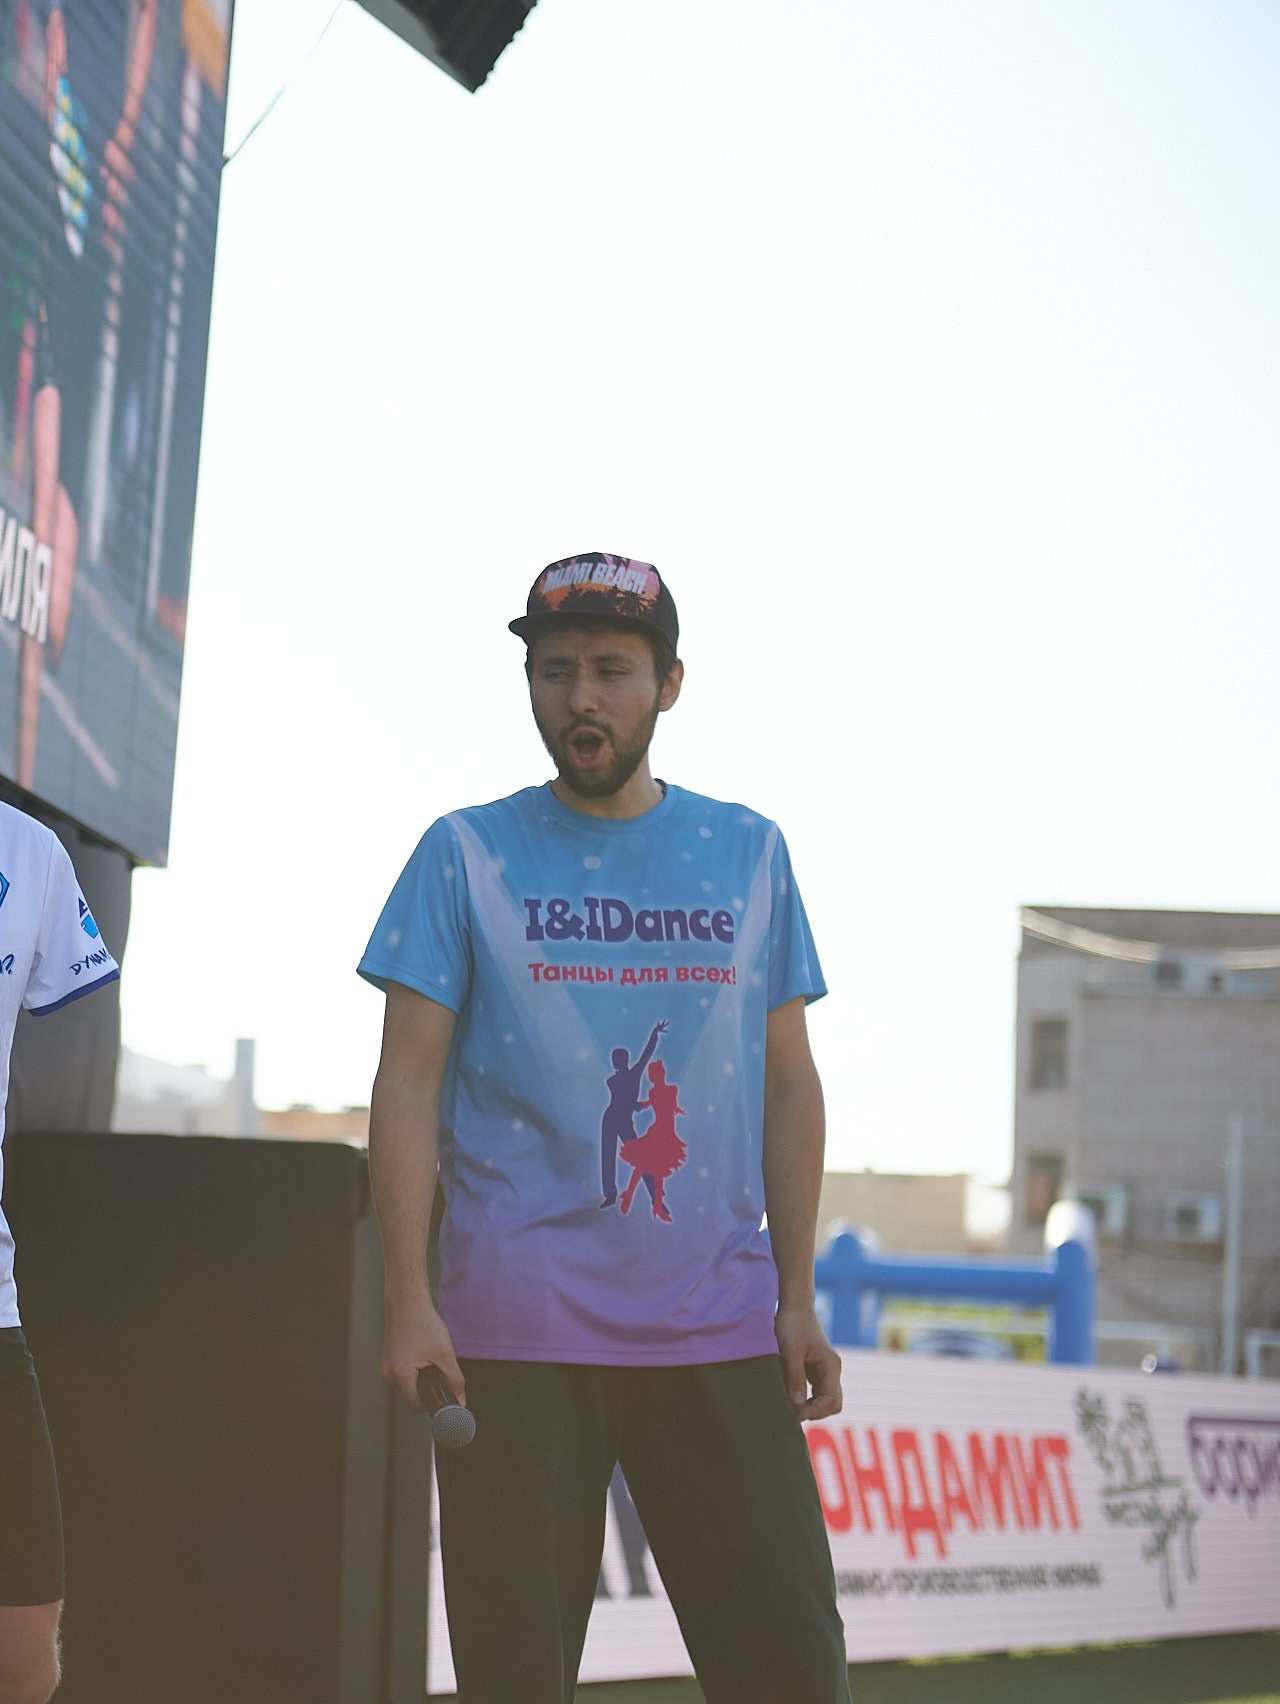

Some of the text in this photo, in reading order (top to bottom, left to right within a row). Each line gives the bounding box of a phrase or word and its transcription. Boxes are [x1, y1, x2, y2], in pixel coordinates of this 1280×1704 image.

[543, 562, 649, 595] MIAMI BEACH
[527, 962, 737, 987] Танцы для всех!
